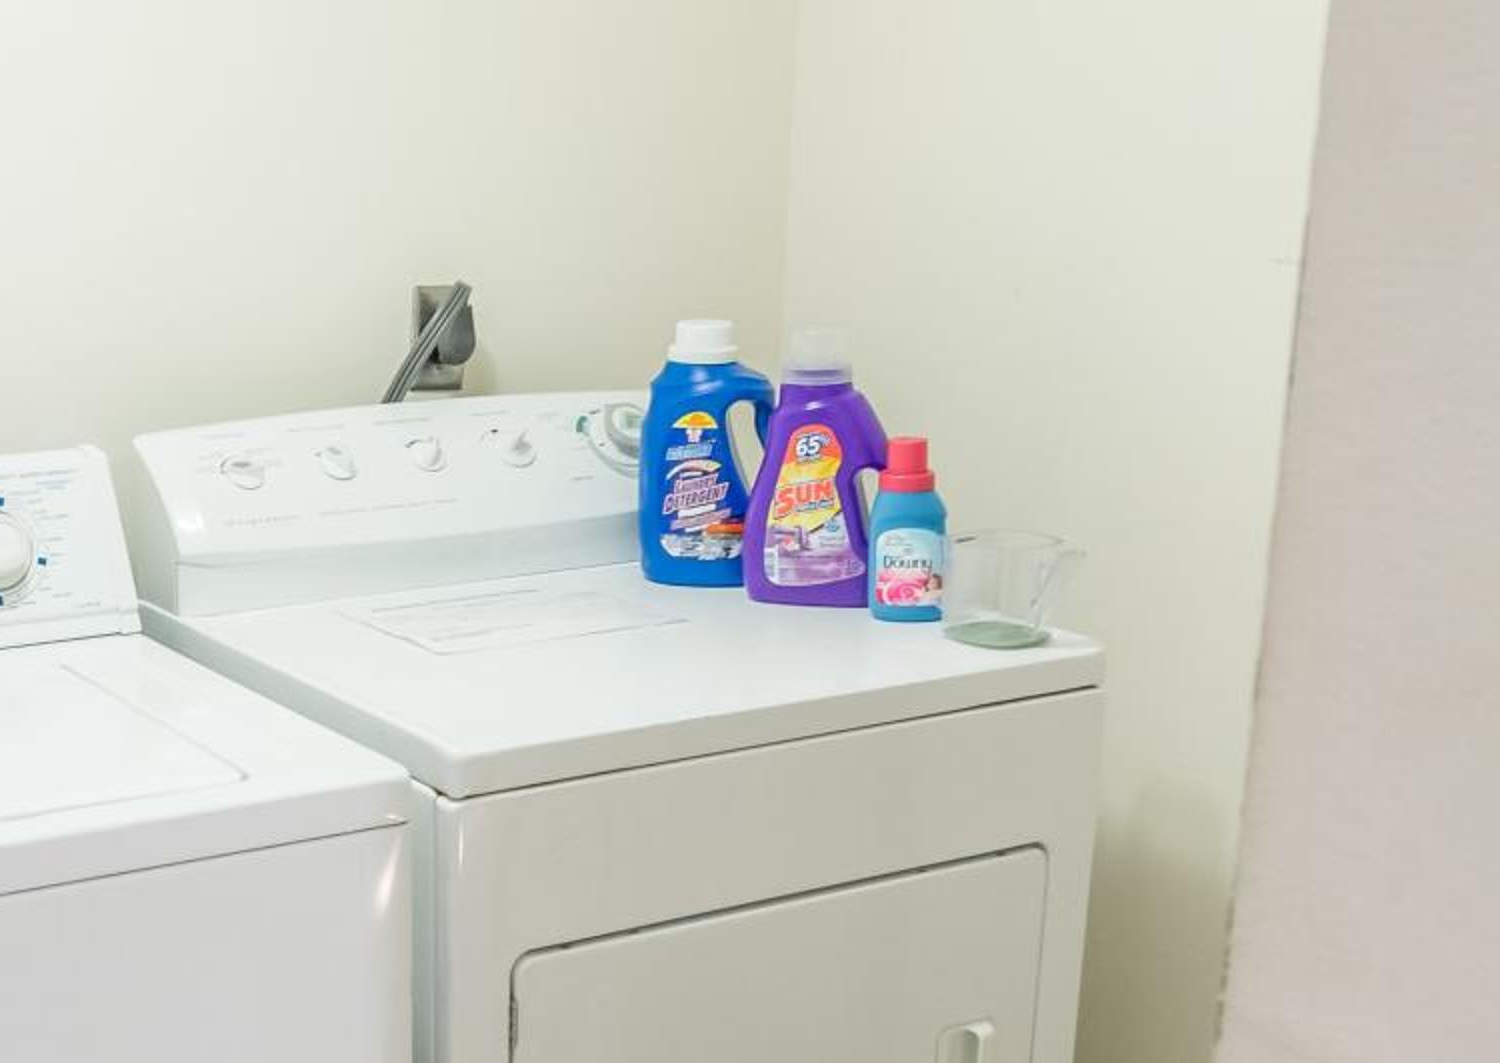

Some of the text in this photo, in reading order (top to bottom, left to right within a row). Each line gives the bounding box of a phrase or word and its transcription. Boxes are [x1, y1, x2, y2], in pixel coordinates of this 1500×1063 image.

[796, 435, 822, 458] 65
[664, 482, 730, 513] DETERGENT
[775, 480, 834, 519] SUN
[884, 555, 933, 573] Downy
